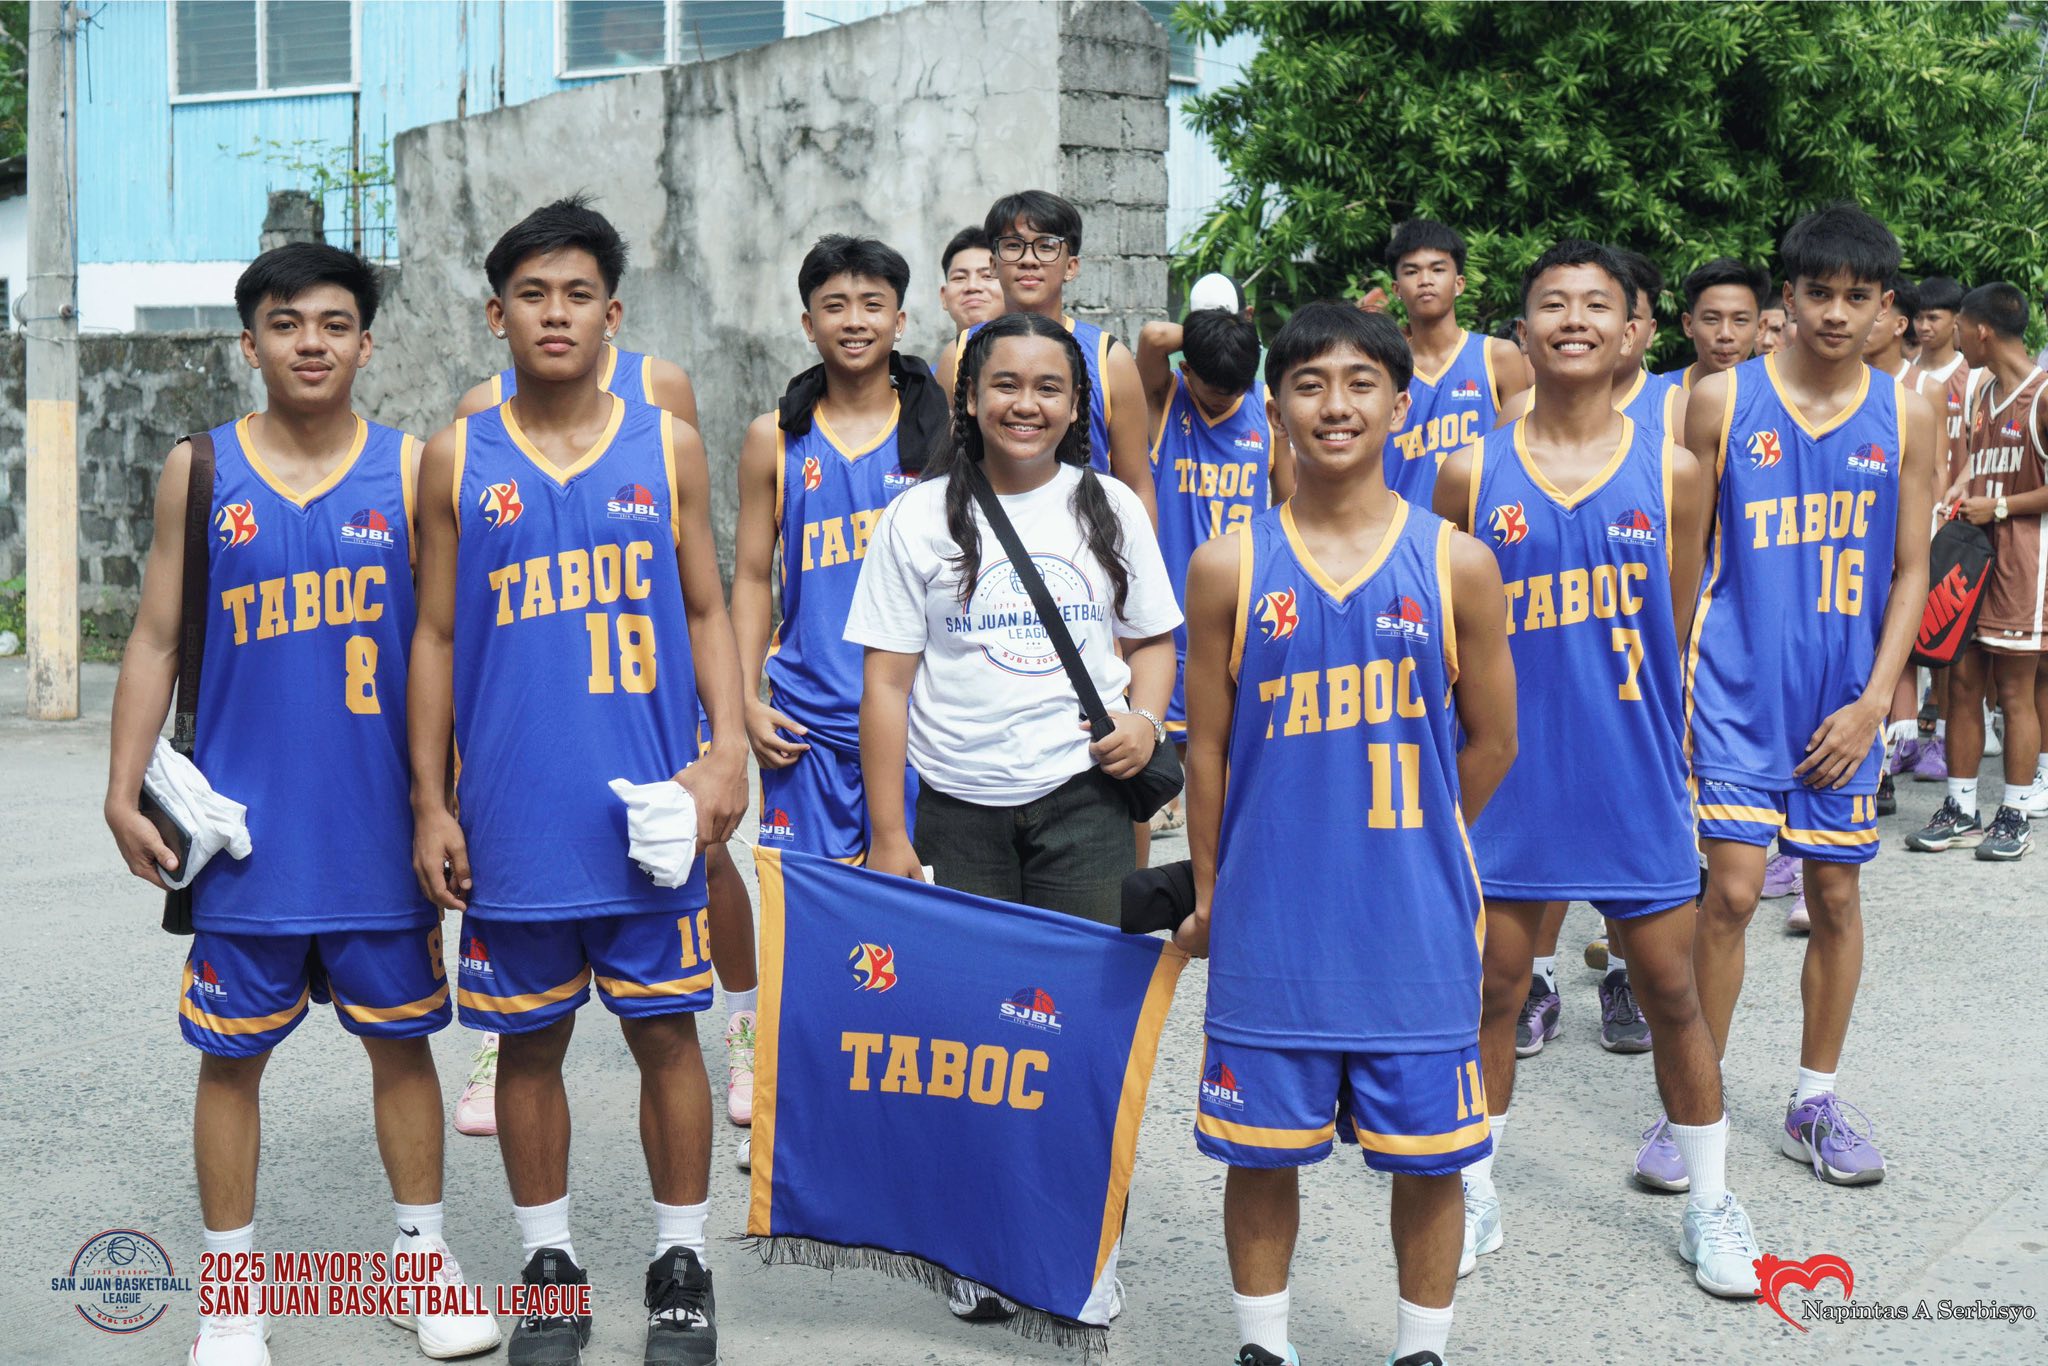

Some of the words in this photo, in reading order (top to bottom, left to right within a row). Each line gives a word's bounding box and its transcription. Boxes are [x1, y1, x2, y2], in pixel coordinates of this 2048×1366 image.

[883, 474, 918, 486] SJB
[1847, 456, 1889, 473] SJBL
[341, 525, 394, 543] SJBL
[607, 501, 660, 517] SJBL
[1607, 525, 1657, 541] SJBL
[1745, 490, 1876, 549] TABOC
[801, 508, 885, 572] TAB
[220, 565, 387, 646] TABOC
[488, 540, 654, 626] TABOC
[1503, 562, 1648, 636] TABOC
[1816, 545, 1865, 616] 16
[1919, 563, 1974, 646] NIKE
[945, 616, 972, 633] SAN
[978, 611, 1018, 631] JUAN
[1008, 626, 1049, 640] LEAGU
[1375, 616, 1430, 637] SJBL
[345, 635, 382, 714] 8
[585, 612, 657, 694] 18
[1001, 651, 1030, 665] SJBL
[1612, 627, 1645, 701] 7
[1258, 656, 1427, 740] TABOC
[1368, 743, 1424, 829] 11
[760, 823, 795, 836] SJBL
[677, 907, 712, 969] 18
[1000, 1002, 1062, 1028] SJBL
[840, 1031, 1050, 1111] TABOC
[1202, 1080, 1244, 1104] SJBL
[1456, 1060, 1485, 1121] 11
